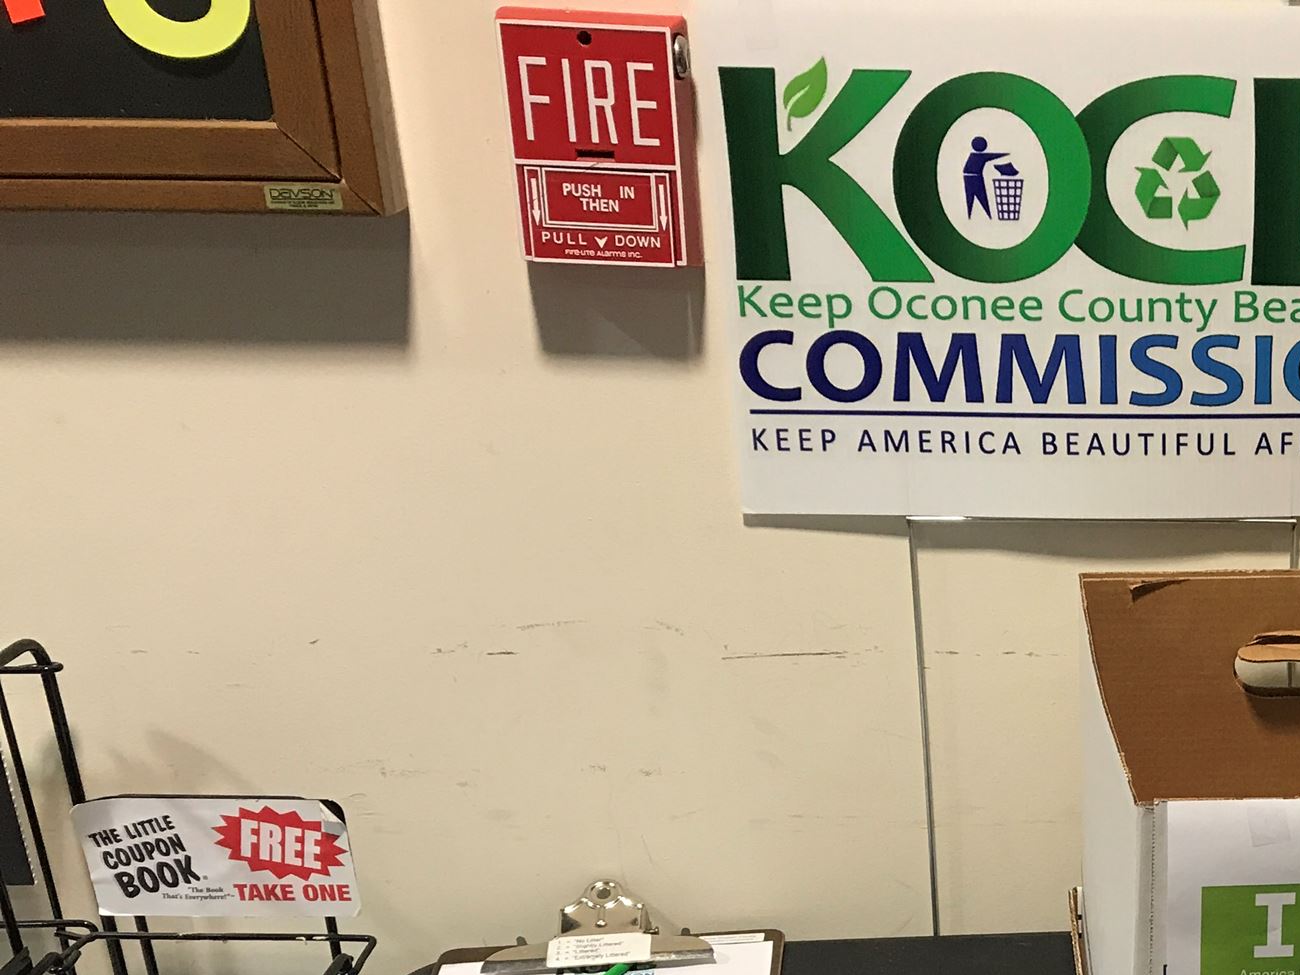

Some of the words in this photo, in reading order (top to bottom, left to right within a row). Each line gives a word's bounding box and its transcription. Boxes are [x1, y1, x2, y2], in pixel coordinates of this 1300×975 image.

[516, 55, 660, 148] FIRE
[562, 183, 601, 197] PUSH
[619, 186, 635, 200] IN
[580, 198, 619, 213] THEN
[541, 231, 587, 246] PULL
[614, 235, 661, 248] DOWN
[738, 285, 854, 328] Keep
[867, 286, 1044, 322] Oconee
[1058, 288, 1218, 332] County
[752, 428, 835, 451] KEEP
[857, 429, 1020, 454] AMERICA
[1042, 432, 1235, 455] BEAUTIFUL
[88, 828, 122, 848] THE
[123, 815, 175, 839] LITTLE
[239, 819, 322, 870] FREE
[102, 834, 186, 870] COUPON
[114, 855, 201, 899] BOOK
[233, 883, 296, 901] TAKE
[302, 884, 352, 902] ONE
[1254, 893, 1296, 959] I
